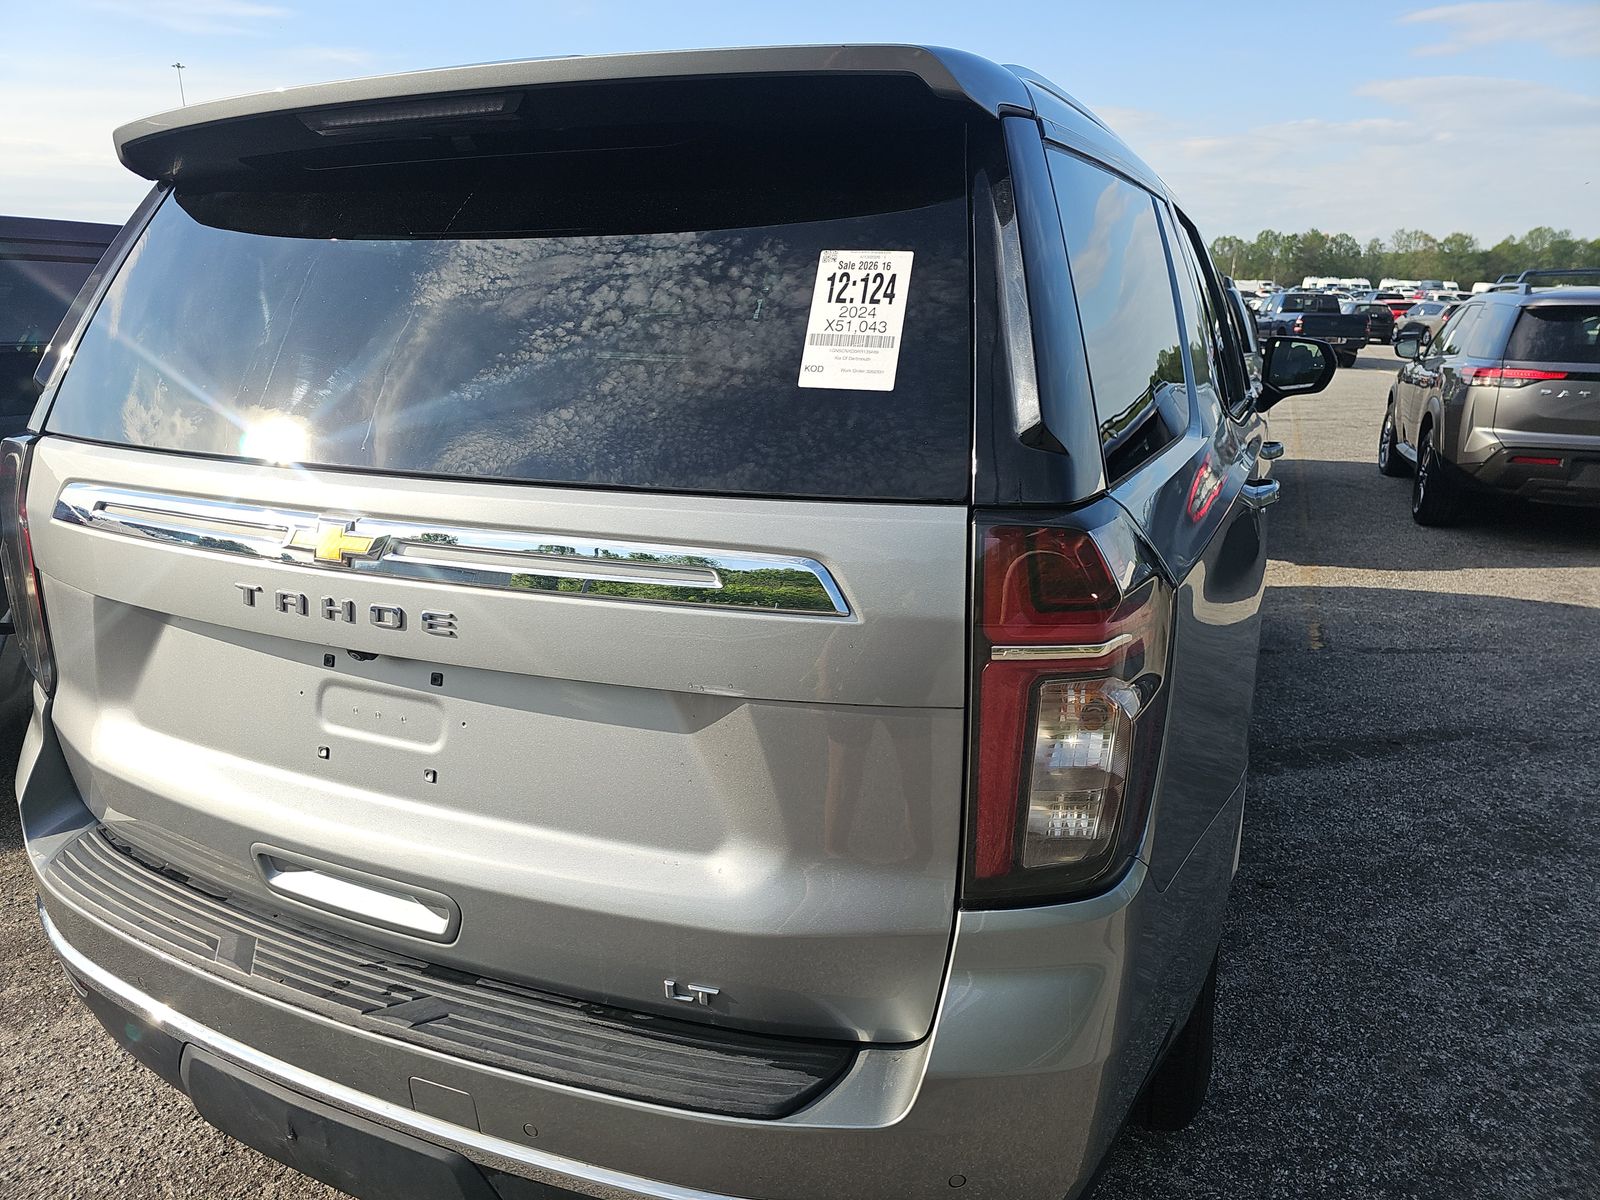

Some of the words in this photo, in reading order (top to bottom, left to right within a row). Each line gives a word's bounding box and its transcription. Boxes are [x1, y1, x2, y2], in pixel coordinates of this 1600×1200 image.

[838, 261, 856, 270] Sale
[858, 261, 879, 270] 2026
[882, 262, 892, 271] 16
[827, 272, 897, 305] 12:124
[839, 306, 877, 318] 2024
[824, 319, 888, 334] X51,043
[804, 365, 824, 373] KOD
[235, 582, 459, 639] TAHOE
[663, 979, 721, 1006] LT
